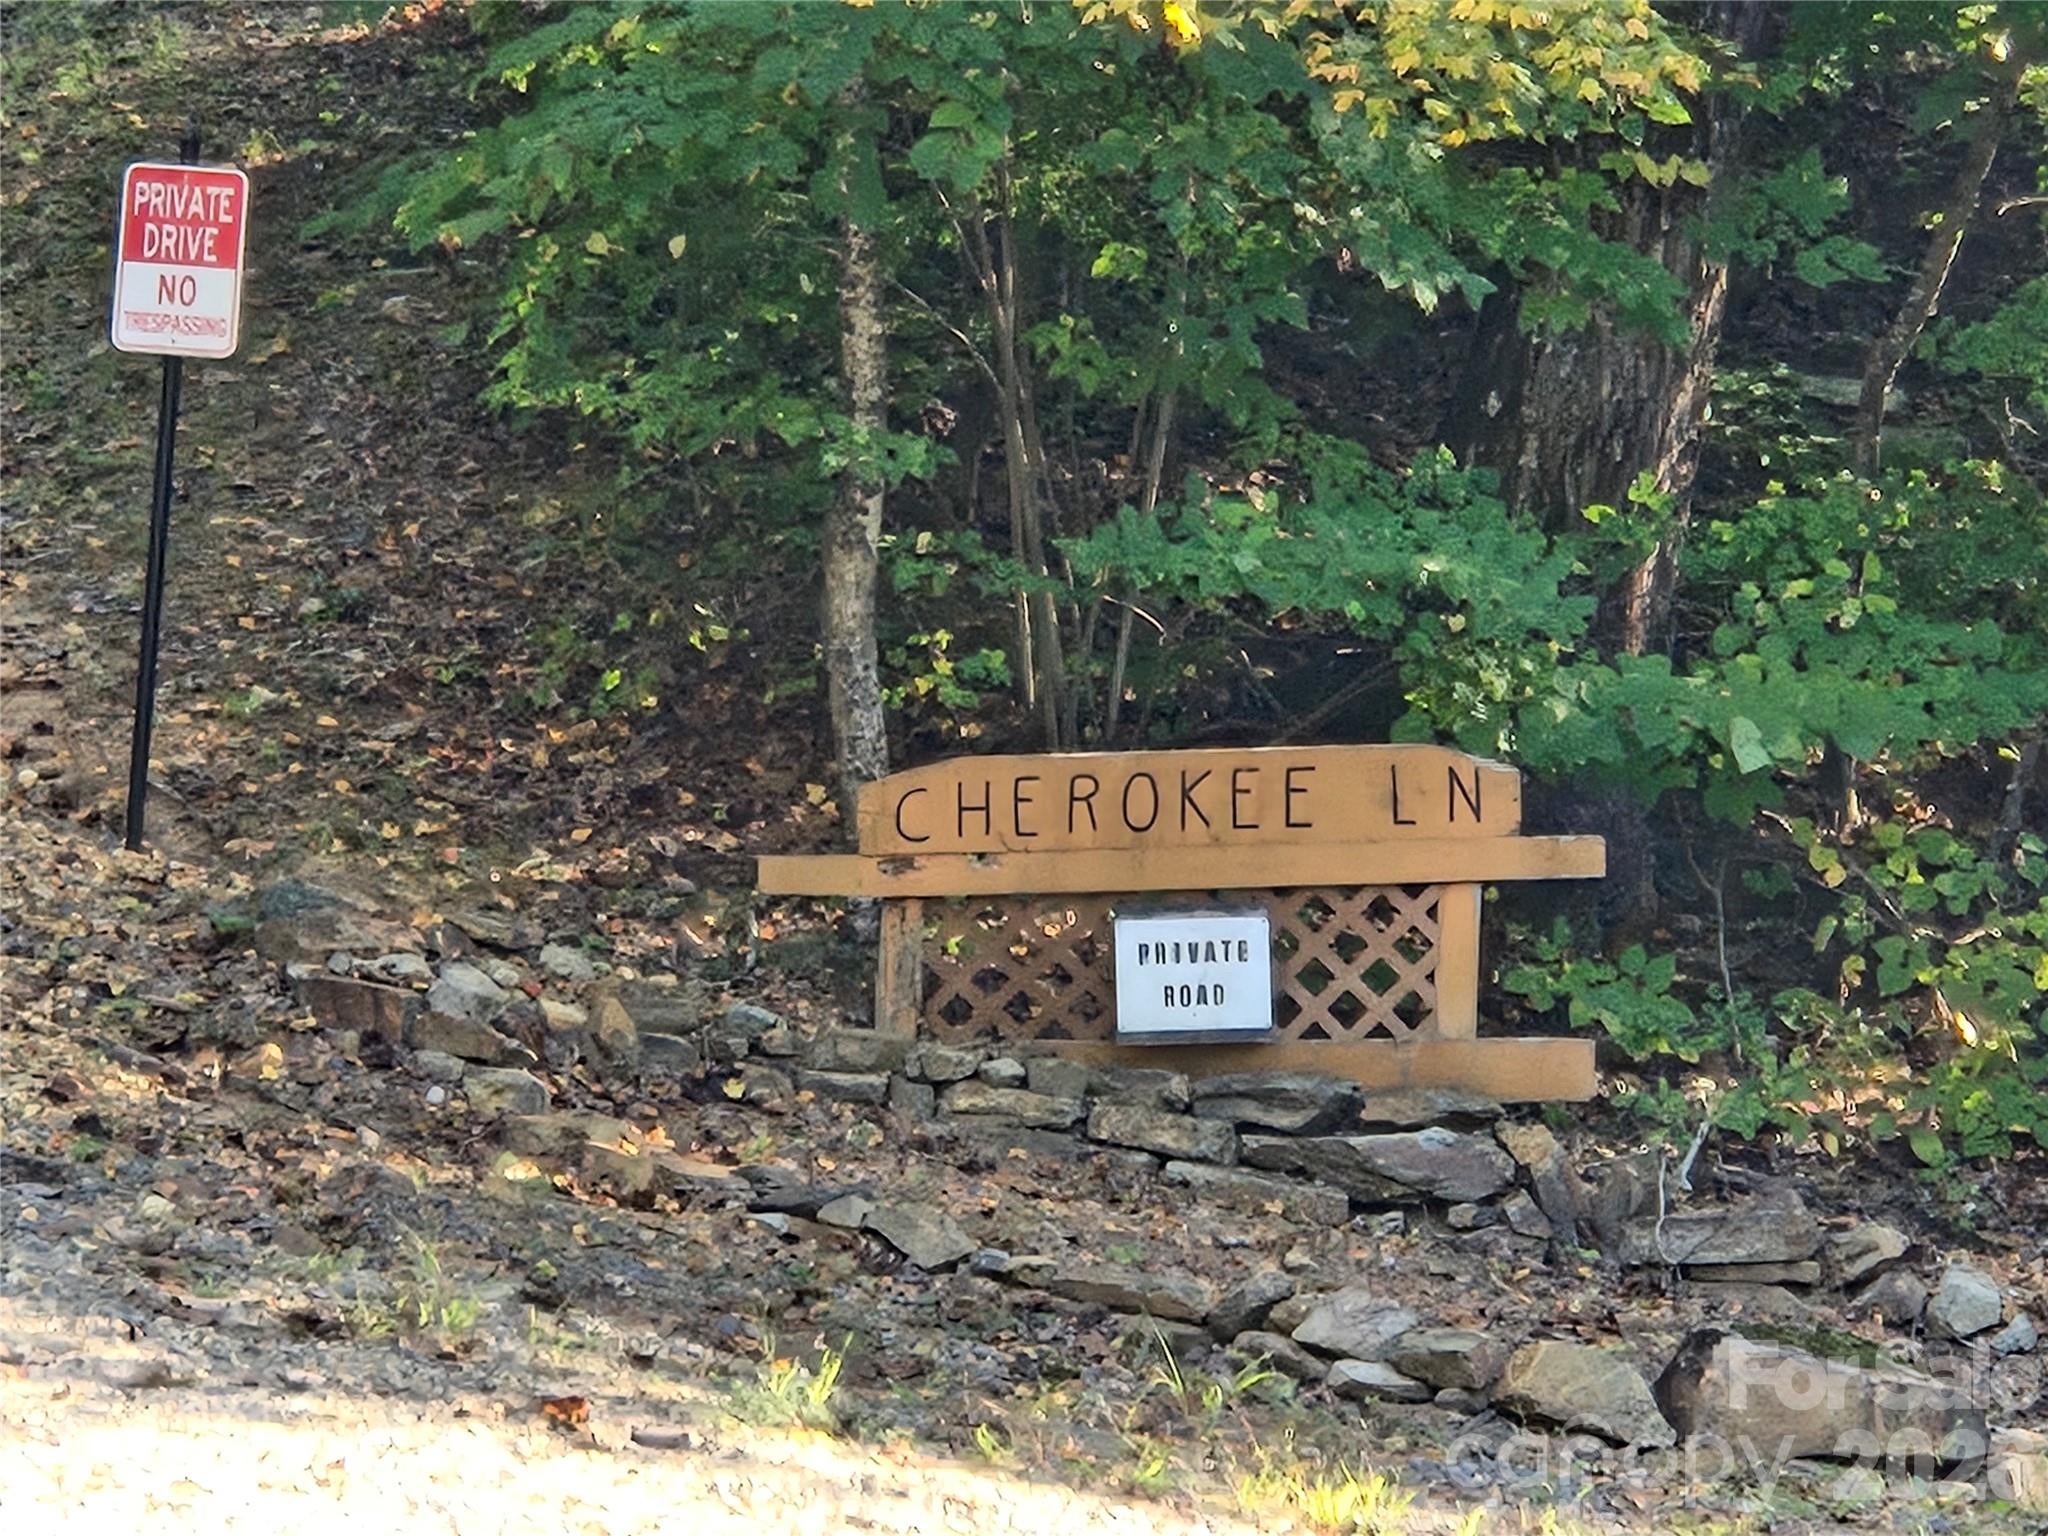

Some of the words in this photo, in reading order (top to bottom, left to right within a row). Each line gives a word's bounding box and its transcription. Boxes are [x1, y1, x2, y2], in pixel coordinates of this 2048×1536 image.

[134, 181, 235, 223] PRIVATE
[143, 222, 219, 262] DRIVE
[158, 274, 196, 307] NO
[895, 765, 1316, 843] CHEROKEE
[1391, 764, 1482, 825] LN
[1137, 939, 1249, 966] PRIVATE
[1163, 983, 1225, 1008] ROAD
